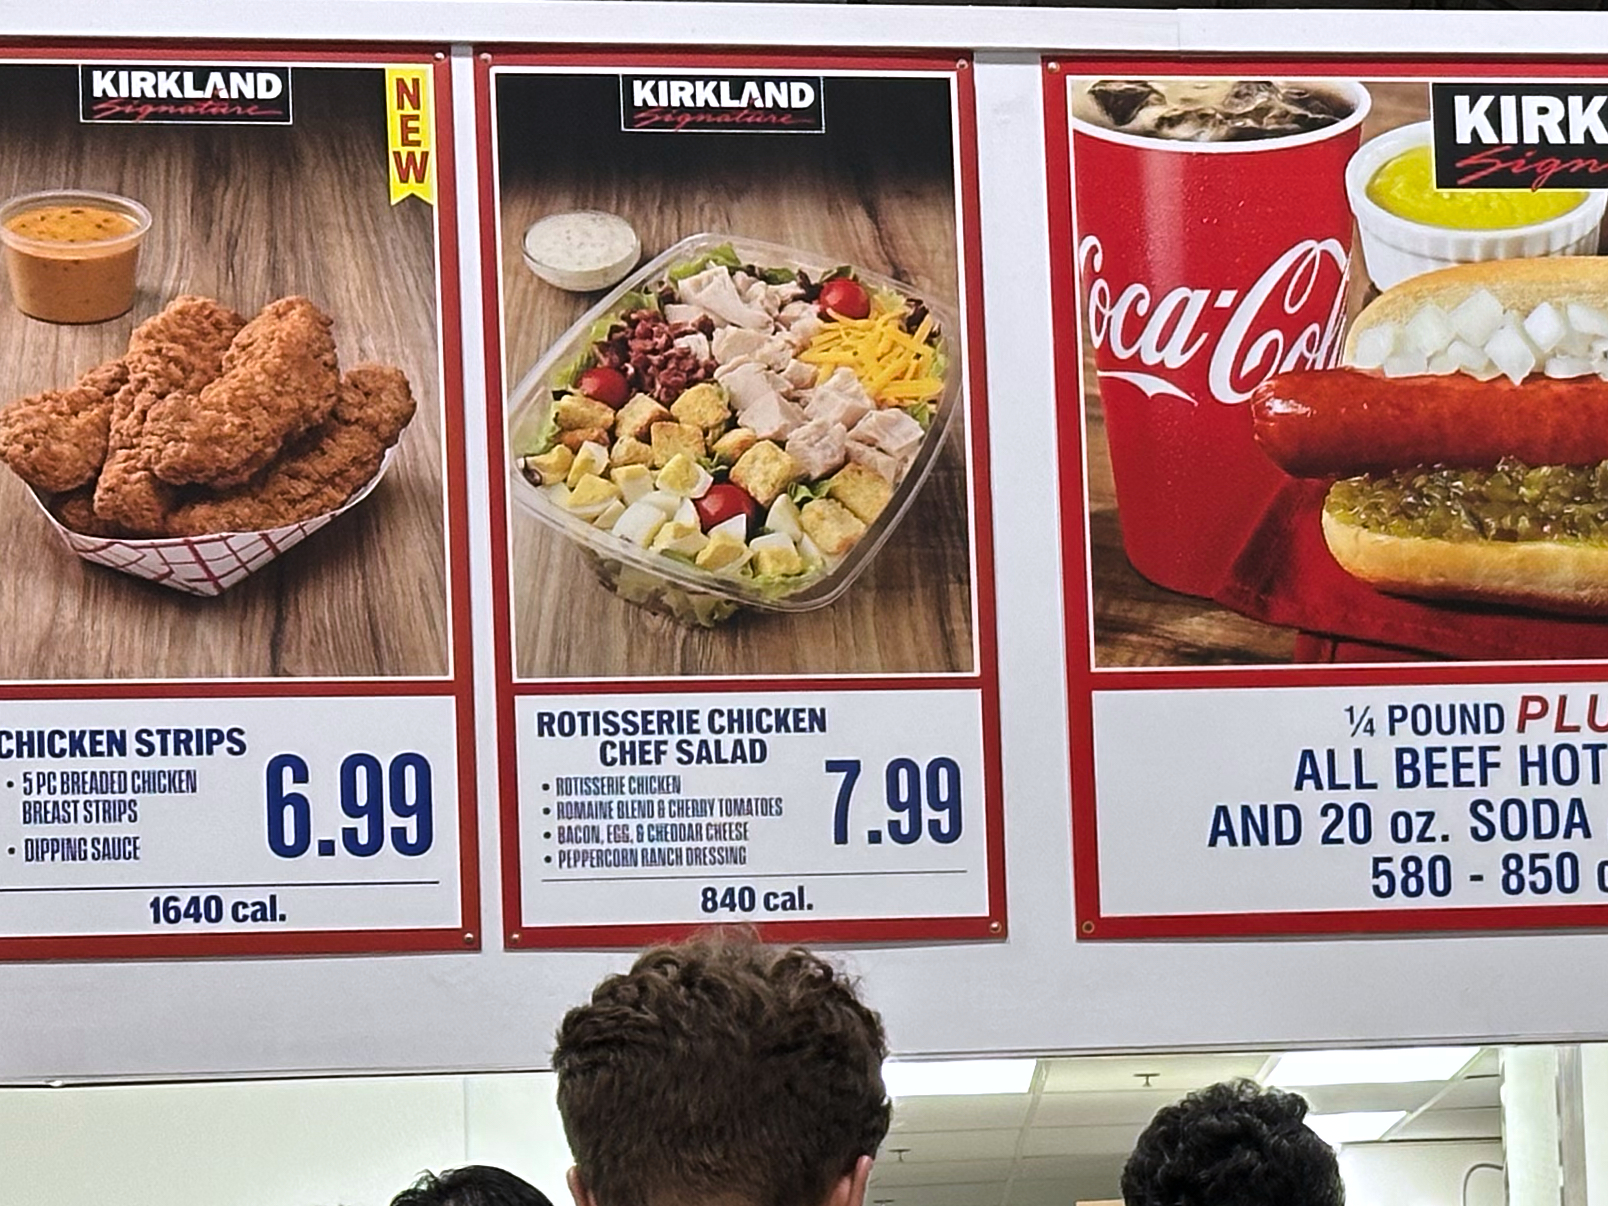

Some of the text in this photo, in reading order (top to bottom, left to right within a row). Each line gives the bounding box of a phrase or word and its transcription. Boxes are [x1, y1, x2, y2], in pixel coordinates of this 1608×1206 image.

[93, 70, 282, 99] KIRKLAND
[632, 79, 815, 108] KIRKLAND
[93, 99, 281, 122] Signature
[633, 107, 816, 132] Signature
[393, 77, 429, 184] NEW
[537, 707, 827, 737] ROTISSERIE CHICKEN
[1388, 703, 1505, 736] POUND
[0, 727, 247, 758] CHICKEN STRIPS
[599, 737, 768, 766] CHEF SALAD
[1294, 748, 1378, 791] ALL
[1395, 745, 1501, 790] BEEF
[1519, 743, 1608, 786] HOT
[23, 769, 197, 796] 5 PC BREADED CHICKEN
[556, 775, 681, 797] ROTISSERIE CHICKEN
[22, 799, 138, 824] BREAST STRIPS
[265, 752, 434, 859] 6.99
[557, 800, 614, 820] ROMAINE
[617, 799, 654, 819] BLEND
[668, 798, 715, 818] CHERRY
[718, 797, 783, 817] TOMATOES
[825, 756, 963, 845] 7.99
[557, 824, 604, 845] BACON,
[607, 823, 634, 844] EGG,
[647, 822, 703, 843] CHEDDAR
[705, 821, 749, 842] CHEESE
[1207, 803, 1302, 847] AND
[1320, 802, 1373, 846] 20
[1390, 811, 1449, 844] oz.
[1469, 797, 1592, 841] SODA
[24, 835, 140, 862] DIPPING SAUCE
[558, 846, 747, 869] PEPPERCORN RANCH DRESSING
[1371, 854, 1452, 899] 580
[1501, 851, 1580, 895] 850
[149, 894, 287, 924] 1640 cal.
[701, 885, 814, 913] 840 cal.
